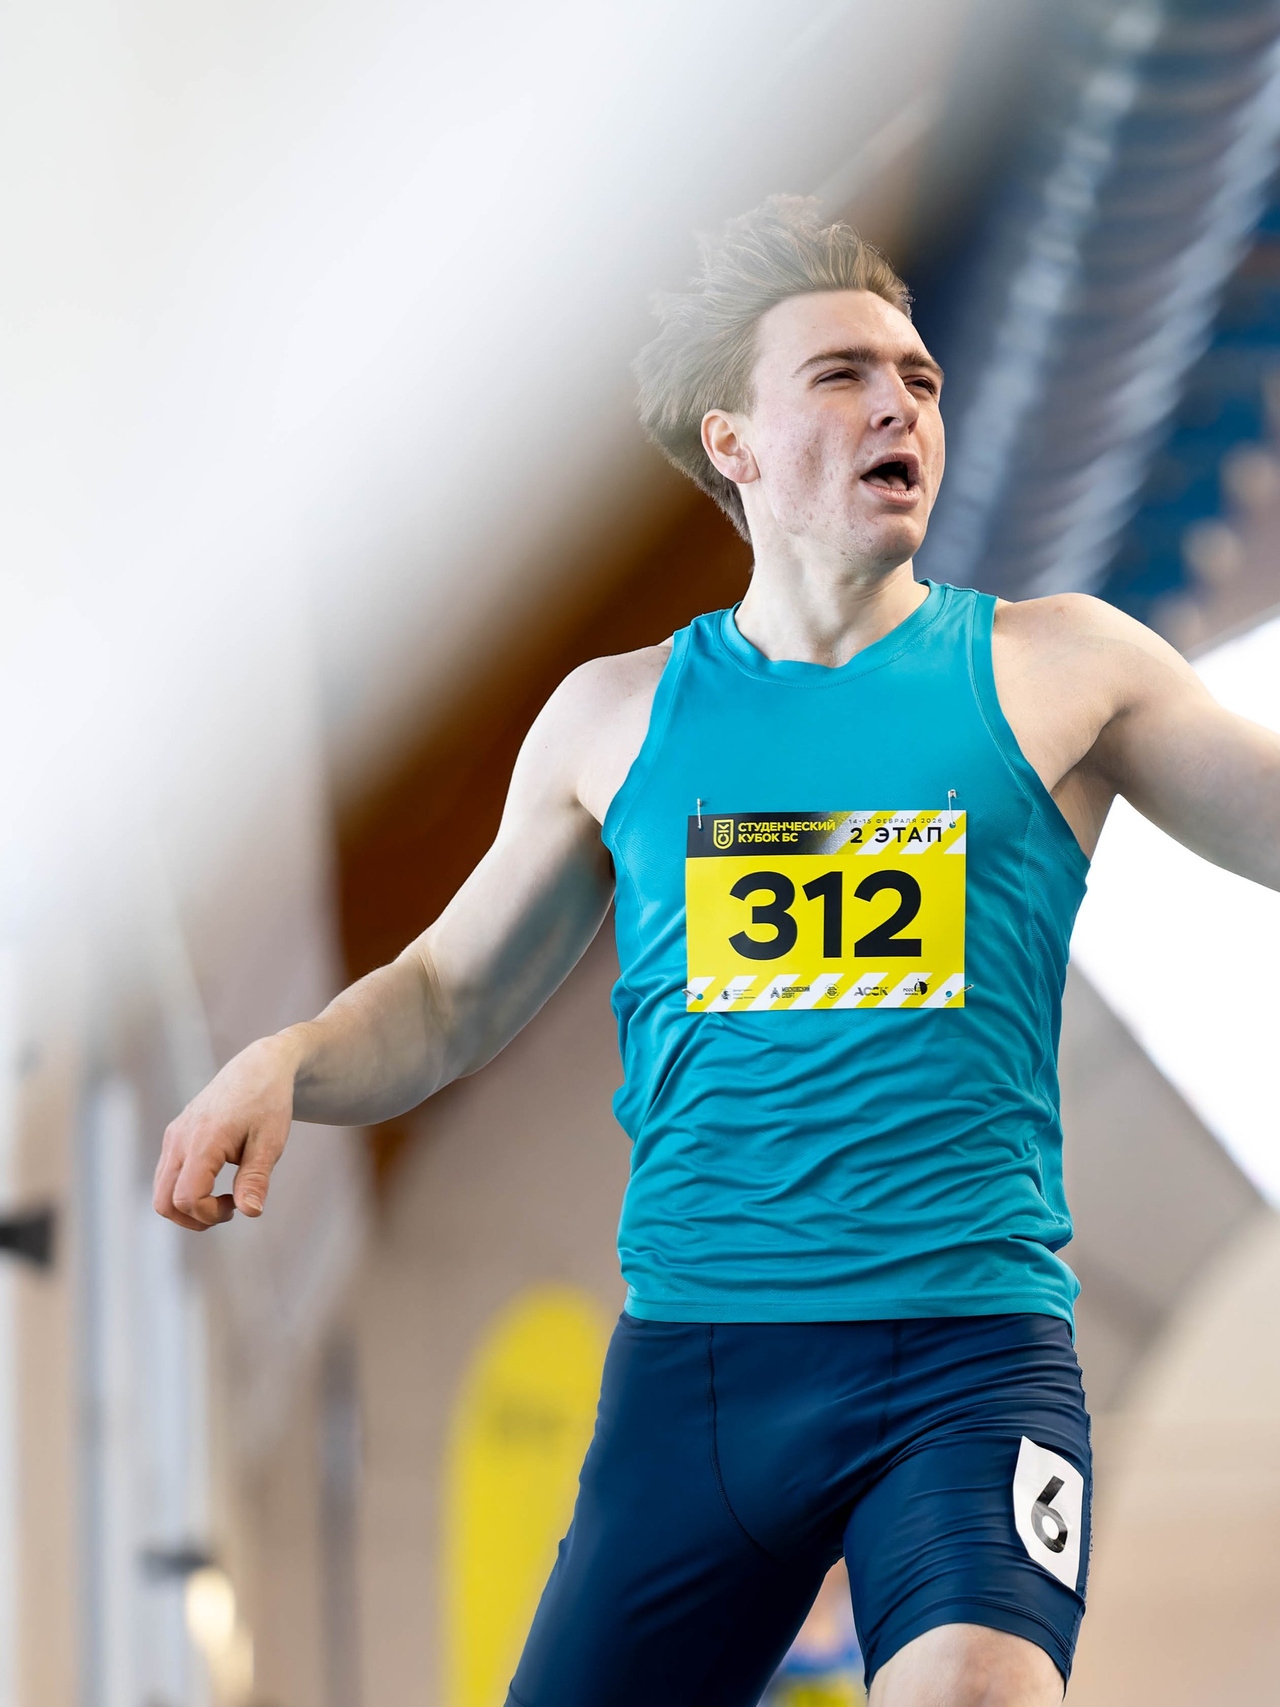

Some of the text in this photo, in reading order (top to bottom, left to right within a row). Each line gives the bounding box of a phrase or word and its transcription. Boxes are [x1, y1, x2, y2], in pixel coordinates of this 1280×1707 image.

[737, 819, 836, 832] СТУДЕНЧЕСКИЙ
[737, 833, 799, 843] КУБОК БС
[850, 826, 942, 843] 2 ЭТАП
[728, 869, 922, 961] 312
[1031, 1475, 1068, 1554] 6
